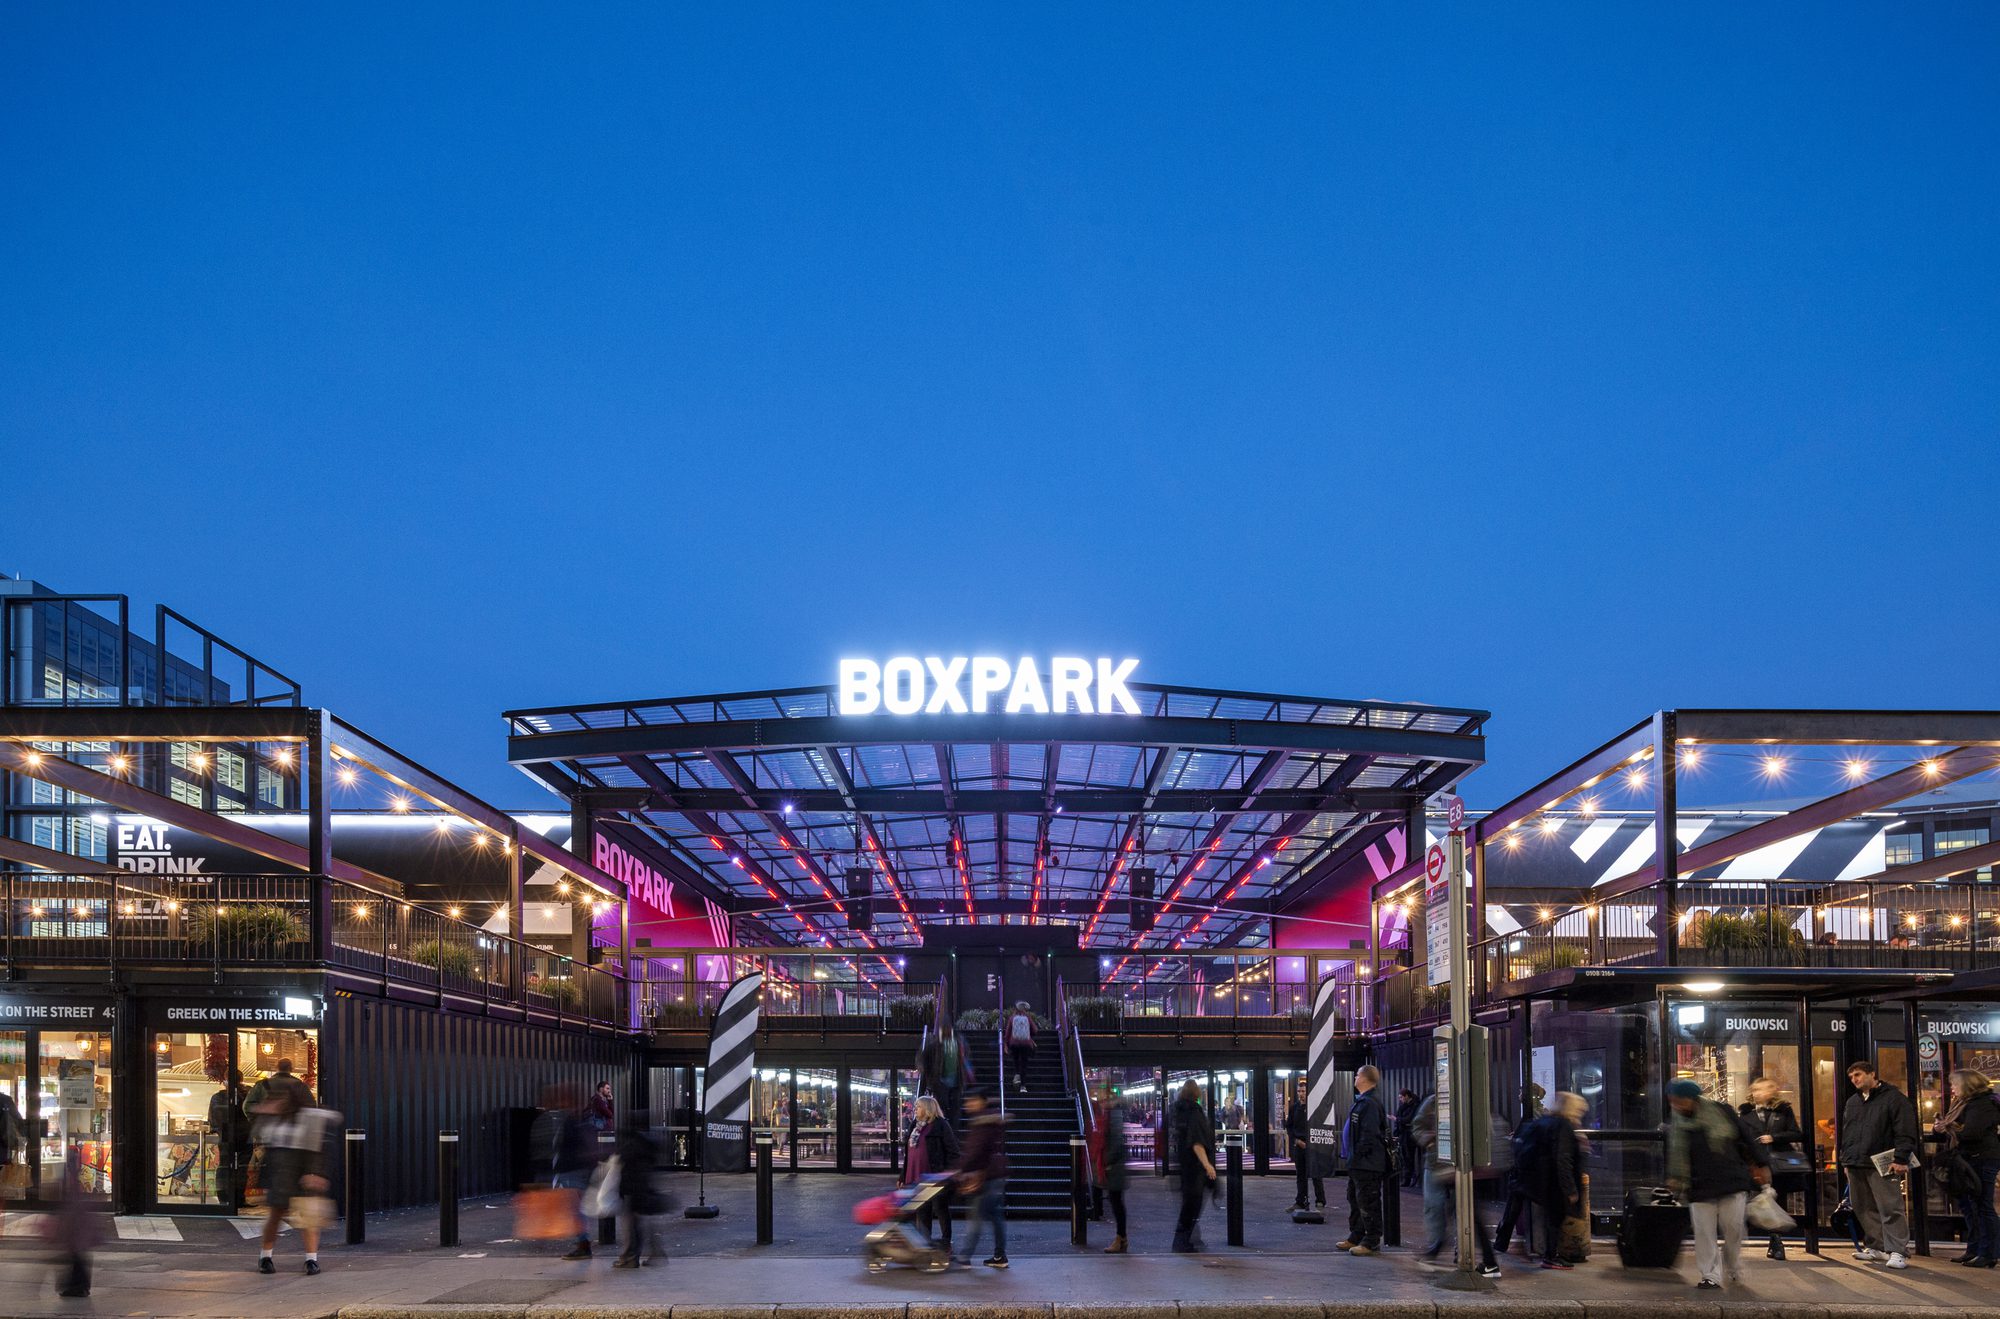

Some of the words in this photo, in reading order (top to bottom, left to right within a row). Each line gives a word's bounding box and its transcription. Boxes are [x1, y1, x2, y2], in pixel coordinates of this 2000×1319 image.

[840, 657, 1142, 714] BOXPARK
[1450, 804, 1461, 823] E8
[118, 825, 171, 850] EAT.
[118, 857, 213, 883] DRINK.
[596, 832, 675, 919] BOXPARK
[5, 1006, 22, 1017] ON
[24, 1006, 48, 1018] THE
[50, 1006, 95, 1018] STREET
[167, 1008, 208, 1020] GREEK
[210, 1008, 226, 1020] ON
[229, 1008, 252, 1020] THE
[1726, 1018, 1788, 1030] BUKOWSKI
[1830, 1020, 1847, 1032] 06
[1928, 1022, 1990, 1034] BUKOWSKI
[708, 1122, 744, 1132] BOXPARK
[1310, 1128, 1334, 1137] BOXPARK
[707, 1131, 744, 1140] CROYDON
[1310, 1136, 1336, 1144] CROYDO
